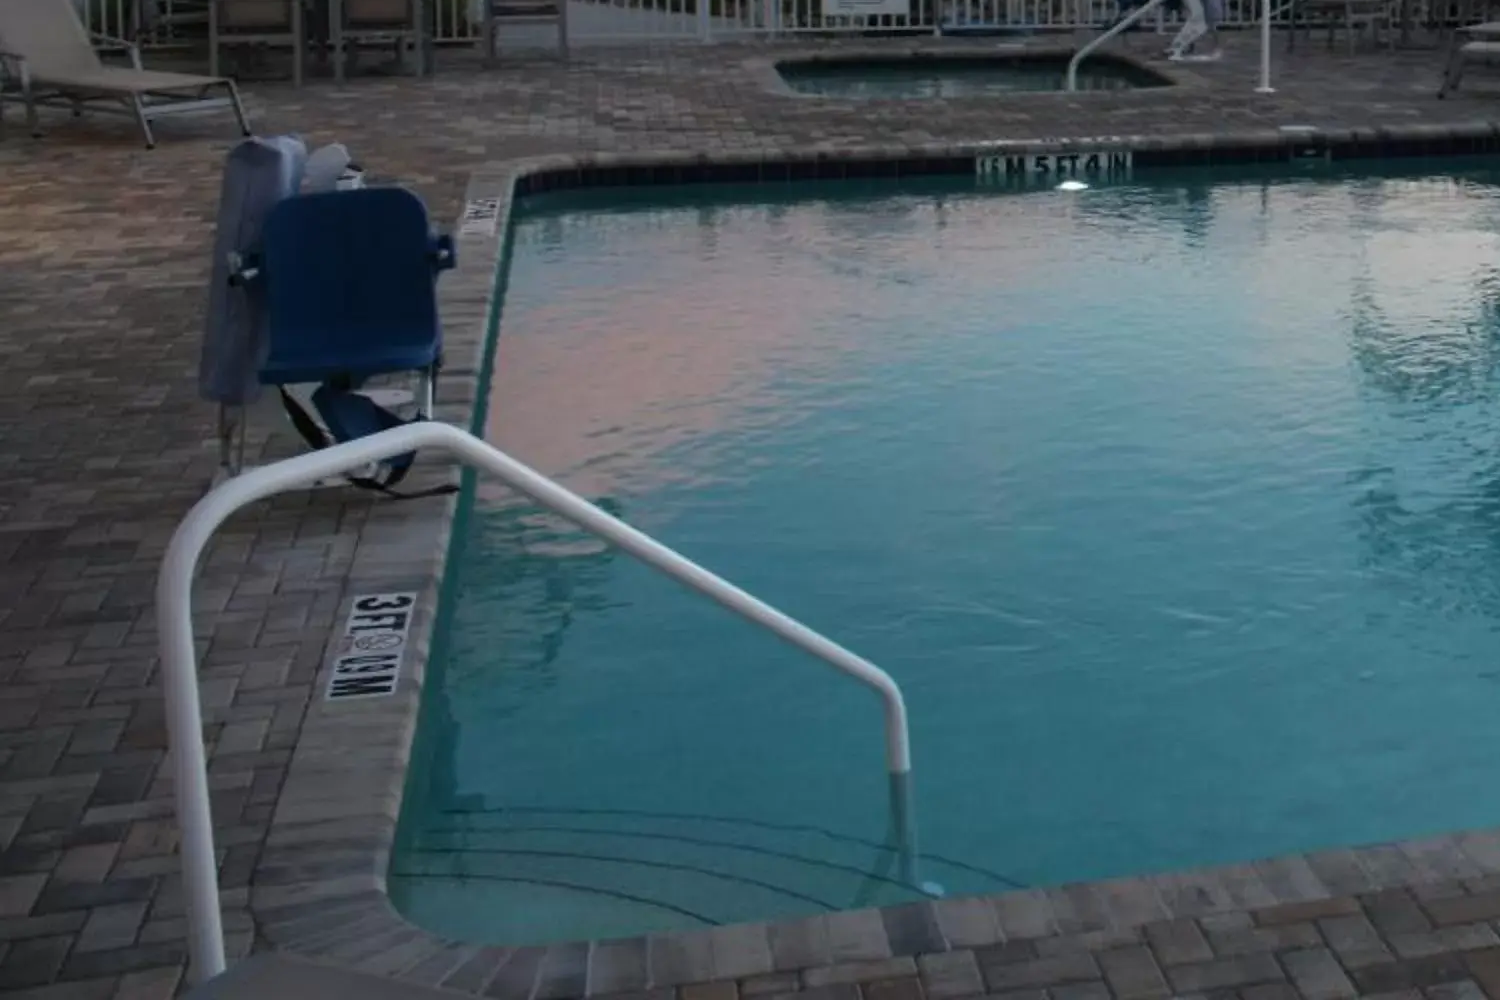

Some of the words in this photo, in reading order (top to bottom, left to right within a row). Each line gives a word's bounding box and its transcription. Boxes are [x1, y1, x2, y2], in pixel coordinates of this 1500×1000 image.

[1035, 154, 1049, 173] 5
[1056, 154, 1080, 173] FT
[356, 595, 413, 612] 3
[349, 613, 408, 634] FT
[329, 675, 395, 698] M
